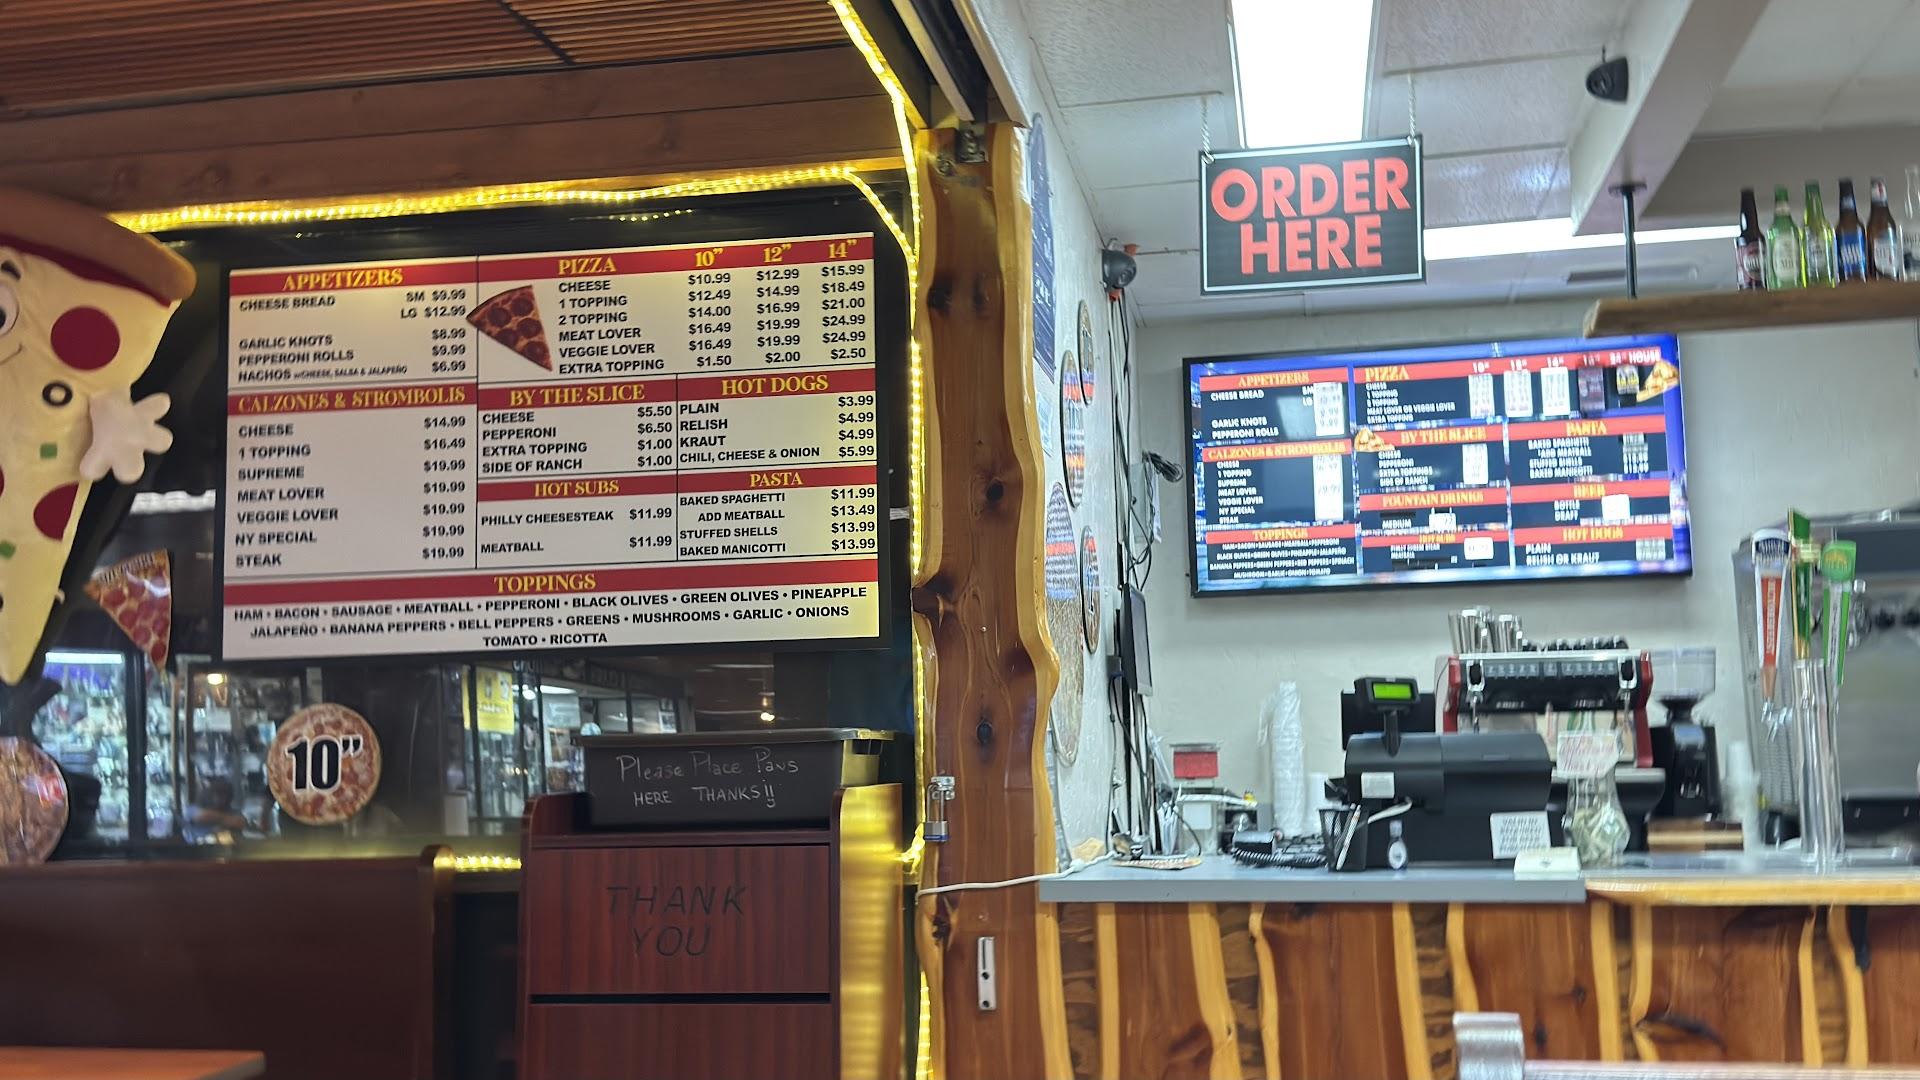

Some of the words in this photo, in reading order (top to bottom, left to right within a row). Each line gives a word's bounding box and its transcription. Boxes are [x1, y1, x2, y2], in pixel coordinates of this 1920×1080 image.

[1211, 157, 1411, 222] ORDER
[1241, 214, 1383, 275] HERE
[559, 257, 617, 275] PIZZA
[282, 268, 403, 291] APPETIZERS
[559, 280, 611, 293] CHEESE
[688, 273, 730, 285] $10.99
[756, 269, 799, 281] $12.99
[821, 265, 864, 277] $15.99
[240, 297, 289, 311] CHEESE
[293, 296, 335, 309] BREAD
[406, 291, 424, 302] SM
[432, 289, 466, 301] $9.99
[559, 300, 565, 309] 1
[569, 296, 627, 308] TOPPING
[688, 289, 731, 302] $12.49
[757, 285, 800, 297] $14.99
[822, 281, 865, 293] $18.49
[401, 308, 417, 319] LG
[424, 305, 466, 318] $12.99
[559, 316, 566, 325] 2
[570, 312, 627, 325] TOPPING
[689, 306, 731, 318] $14.00
[757, 302, 800, 314] $16.99
[822, 298, 865, 310] $21.00
[239, 337, 285, 349] GARLIC
[289, 335, 333, 348] KNOTS
[432, 328, 466, 340] $8.99
[559, 330, 595, 342] MEAT
[598, 328, 641, 340] LOVER
[689, 322, 731, 335] $16.49
[757, 318, 800, 331] $19.99
[822, 315, 865, 327] $24.99
[560, 346, 608, 358] VEGGIE
[612, 344, 655, 355] LOVER
[689, 339, 731, 351] $16.49
[757, 335, 800, 347] $19.99
[822, 331, 866, 344] $24.99
[239, 353, 310, 366] PEPPERONI
[314, 350, 354, 362] ROLLS
[432, 345, 466, 356] $9.99
[559, 362, 603, 374] EXTRA
[606, 360, 664, 372] TOPPING
[697, 355, 732, 367] $1.50
[765, 351, 801, 363] $2.00
[831, 348, 866, 360] $2.50
[238, 369, 291, 382] NACHOS
[432, 361, 466, 372] $6.99
[1365, 366, 1409, 381] PIZZA
[510, 390, 536, 406] BY
[540, 387, 583, 404] THE
[586, 384, 645, 402] SLICE
[721, 378, 766, 395] HOT
[771, 375, 829, 393] DOGS
[238, 393, 329, 413] CALZONES
[335, 393, 346, 408] &
[352, 387, 466, 407] STROMBOLIS
[680, 403, 719, 414] PLAIN
[838, 395, 873, 407] $3.99
[483, 412, 534, 424] CHEESE
[637, 406, 672, 417] $5.50
[680, 419, 728, 431] RELISH
[838, 412, 874, 424] $4.99
[239, 424, 294, 438] CHEESE
[424, 416, 466, 429] $14.99
[483, 427, 556, 440] PEPPERONI
[637, 423, 672, 434] $6.50
[1212, 429, 1254, 439] PEPPERONI
[1256, 427, 1279, 437] ROLLS
[483, 445, 526, 456] EXTRA
[529, 443, 588, 455] TOPPING
[637, 438, 672, 450] $1.00
[680, 436, 726, 447] KRAUT
[838, 429, 874, 441] $4.99
[239, 448, 245, 460] 1
[249, 445, 311, 459] TOPPING
[424, 438, 466, 450] $16.49
[679, 453, 715, 464] CHILI,
[718, 450, 767, 461] CHEESE
[769, 449, 777, 458] &
[780, 447, 820, 458] ONION
[839, 446, 874, 458] $5.99
[238, 467, 304, 481] SUPREME
[424, 460, 465, 472] $19.99
[482, 462, 512, 473] SIDE
[516, 461, 532, 471] OF
[536, 459, 582, 470] RANCH
[637, 455, 672, 467] $1.00
[535, 482, 572, 497] HOT
[575, 480, 619, 495] SUBS
[750, 472, 803, 488] PASTA
[238, 490, 275, 502] MEAT
[279, 487, 324, 500] LOVER
[424, 482, 465, 494] $19.99
[680, 496, 719, 506] BAKED
[722, 493, 785, 504] SPAGHETTI
[831, 488, 875, 500] $11.99
[238, 511, 288, 524] VEGGIE
[293, 509, 338, 521] LOVER
[423, 504, 465, 516] $19.99
[481, 515, 522, 526] PHILLY
[526, 511, 614, 523] CHEESESTEAK
[629, 508, 672, 520] $11.99
[698, 513, 721, 522] ADD
[724, 510, 785, 520] MEATBALL
[831, 505, 875, 517] $13.49
[679, 529, 731, 539] STUFFED
[734, 526, 778, 536] SHELLS
[831, 522, 875, 534] $13.99
[1382, 519, 1411, 529] MEDIUM
[235, 534, 255, 545] NY
[258, 532, 317, 545] SPECIAL
[423, 526, 464, 538] $19.99
[481, 542, 544, 553] MEATBALL
[629, 536, 672, 548] $11.99
[680, 547, 719, 556] BAKED
[722, 544, 785, 555] MANICOTTI
[831, 538, 875, 550] $13.99
[1526, 543, 1551, 554] PLAIN
[236, 554, 281, 567] STEAK
[423, 548, 464, 559] $19.99
[493, 573, 596, 593] TOPPINGS
[234, 610, 263, 621] HAM
[275, 608, 319, 619] BACON
[331, 604, 392, 617] SAUSAGE
[404, 602, 473, 614] MEATBALL
[485, 598, 560, 611] PEPPERONI
[572, 596, 617, 608] BLACK
[620, 594, 668, 606] OLIVES
[681, 592, 726, 604] GREEN
[730, 590, 779, 602] OLIVES
[791, 587, 867, 599] PINEAPPLE
[250, 624, 318, 638] JALAPEÑO
[330, 622, 384, 635] BANANA
[387, 620, 446, 633] PEPPERS
[458, 619, 491, 630] BELL
[494, 617, 553, 629] PEPPERS
[566, 614, 620, 626] GREENS
[632, 610, 720, 624] MUSHROOMS
[733, 608, 783, 620] GARLIC
[795, 605, 850, 618] ONIONS
[483, 635, 538, 647] TOMATO
[550, 633, 607, 644] RICOTTA
[615, 755, 684, 782] Please
[690, 750, 742, 776] Place
[633, 791, 672, 807] HERE
[608, 886, 746, 915] THANK
[632, 926, 711, 957] YOU
